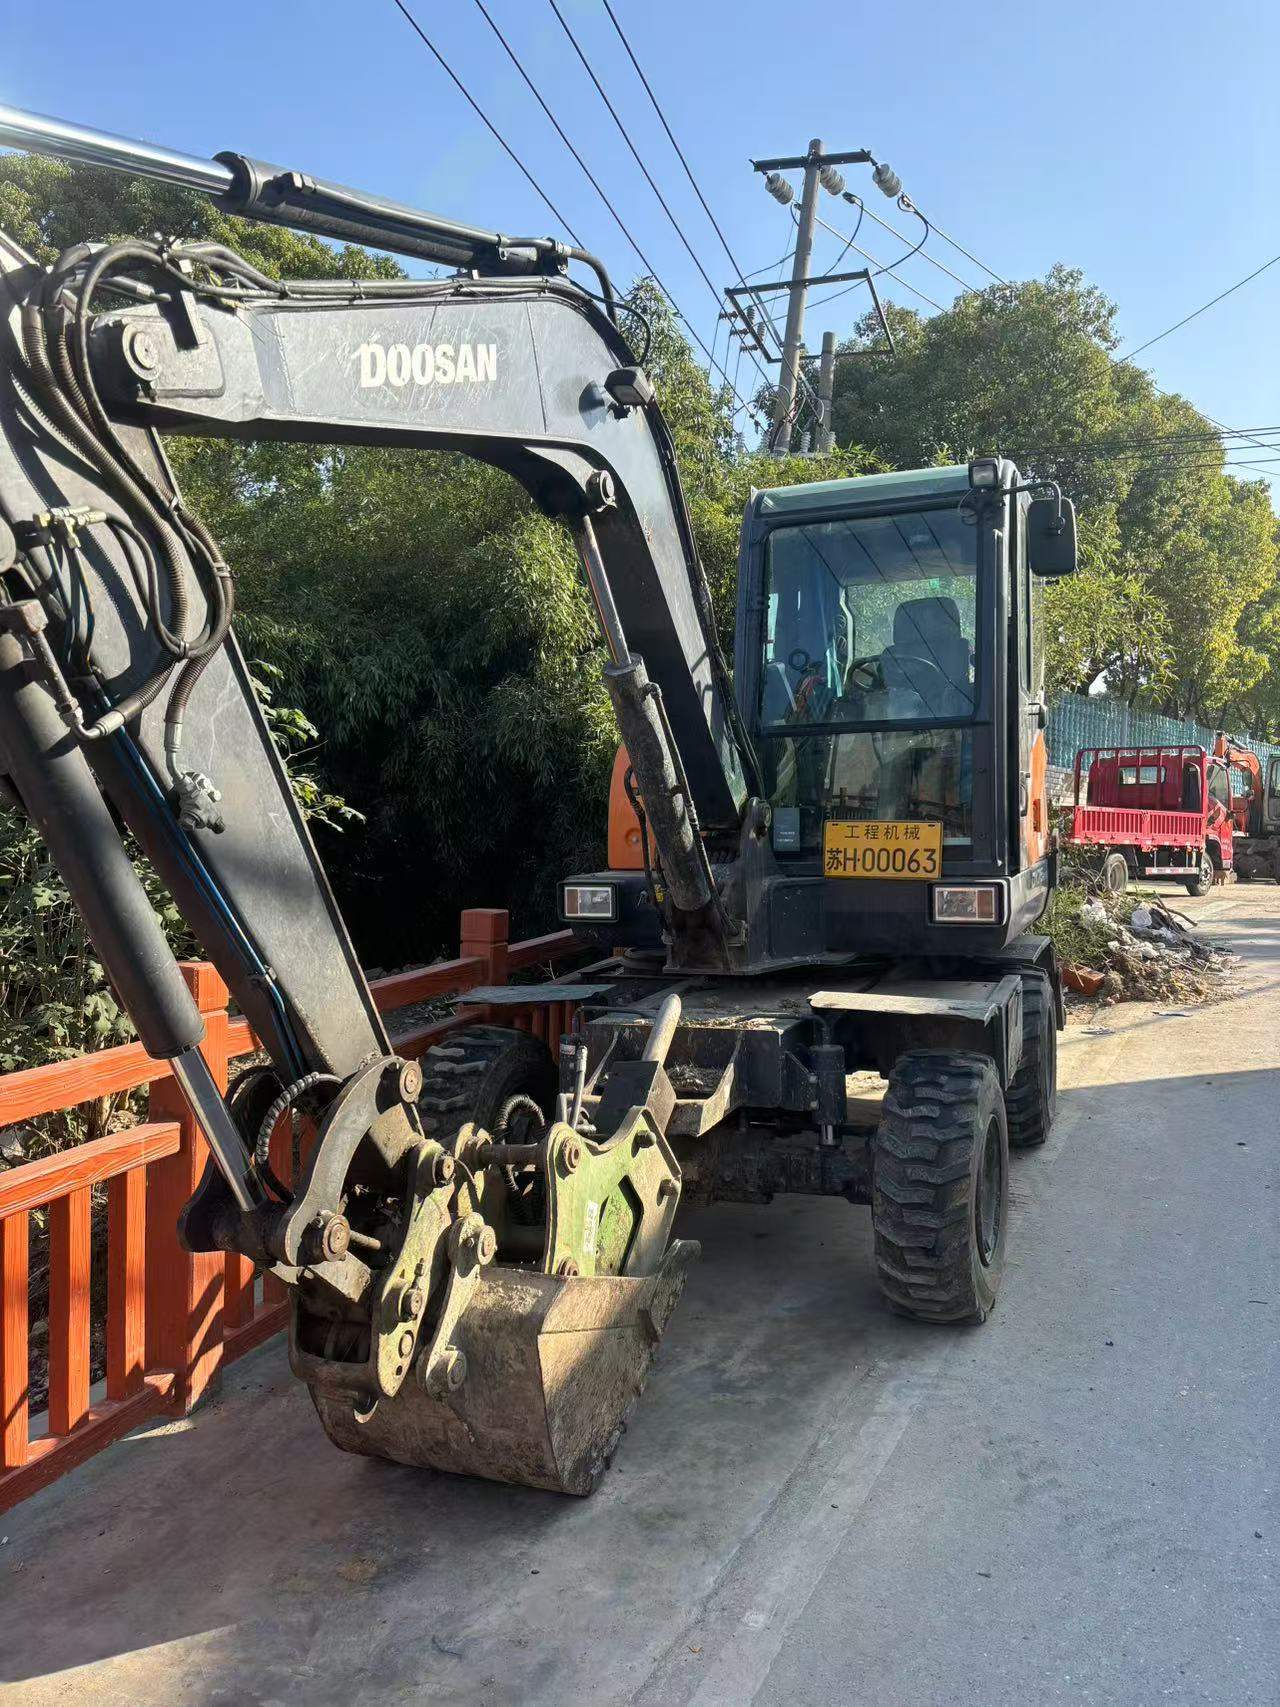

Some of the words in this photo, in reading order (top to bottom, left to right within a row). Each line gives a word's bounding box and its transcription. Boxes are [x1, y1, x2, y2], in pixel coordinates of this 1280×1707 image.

[361, 344, 496, 387] DOOSAN
[844, 824, 921, 840] 工程机械
